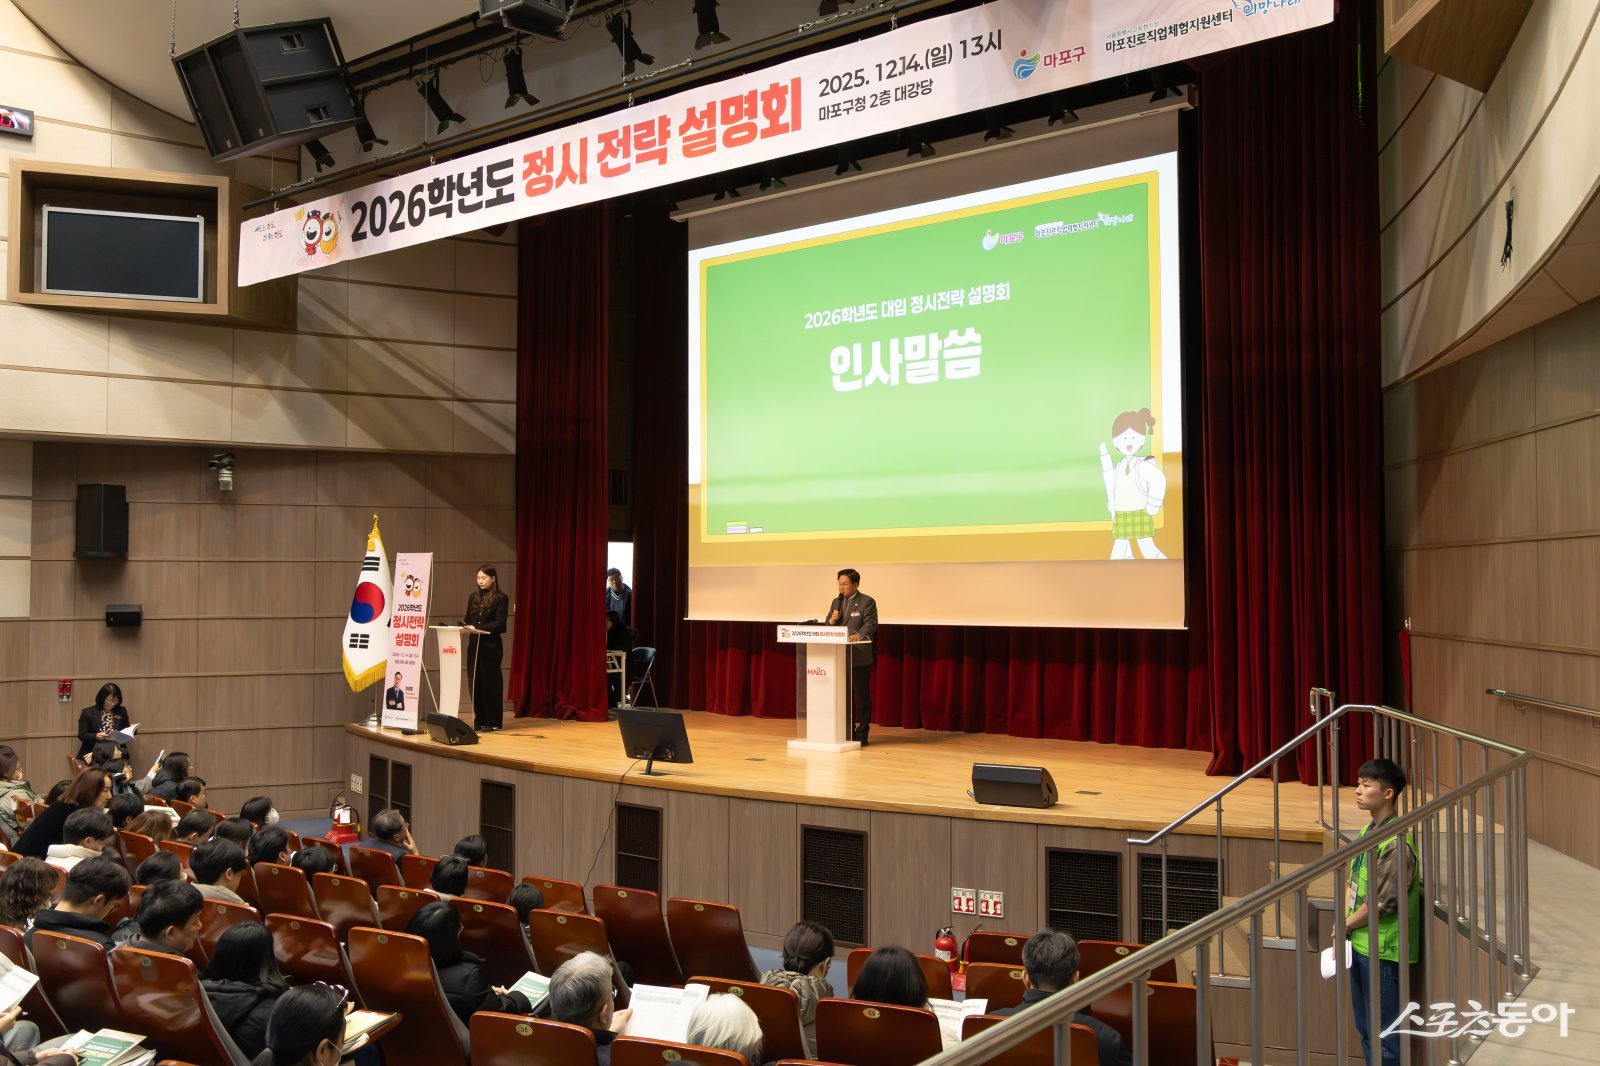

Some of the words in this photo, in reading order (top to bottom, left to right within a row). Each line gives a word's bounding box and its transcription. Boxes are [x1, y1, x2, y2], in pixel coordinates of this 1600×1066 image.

[1105, 9, 1233, 52] 마포진로직업체험지원센터
[818, 68, 870, 97] 2025.
[959, 29, 1002, 59] 13시
[1043, 45, 1086, 68] 마포구
[818, 96, 866, 121] 마포구청
[869, 89, 891, 108] 2층
[894, 78, 934, 103] 대강당
[351, 158, 515, 242] 2026학년도
[522, 136, 588, 198] 정시
[597, 114, 671, 178] 전략
[678, 76, 802, 159] 설명회
[1000, 231, 1024, 245] 마포구
[804, 303, 878, 329] 2026학년도
[881, 297, 907, 318] 대입
[910, 288, 965, 314] 정시전략
[968, 281, 1011, 306] 설명회
[829, 326, 982, 392] 인사말씀
[393, 615, 424, 629] 정시전략
[398, 604, 422, 612] 2026학년도
[396, 633, 419, 647] 설명회
